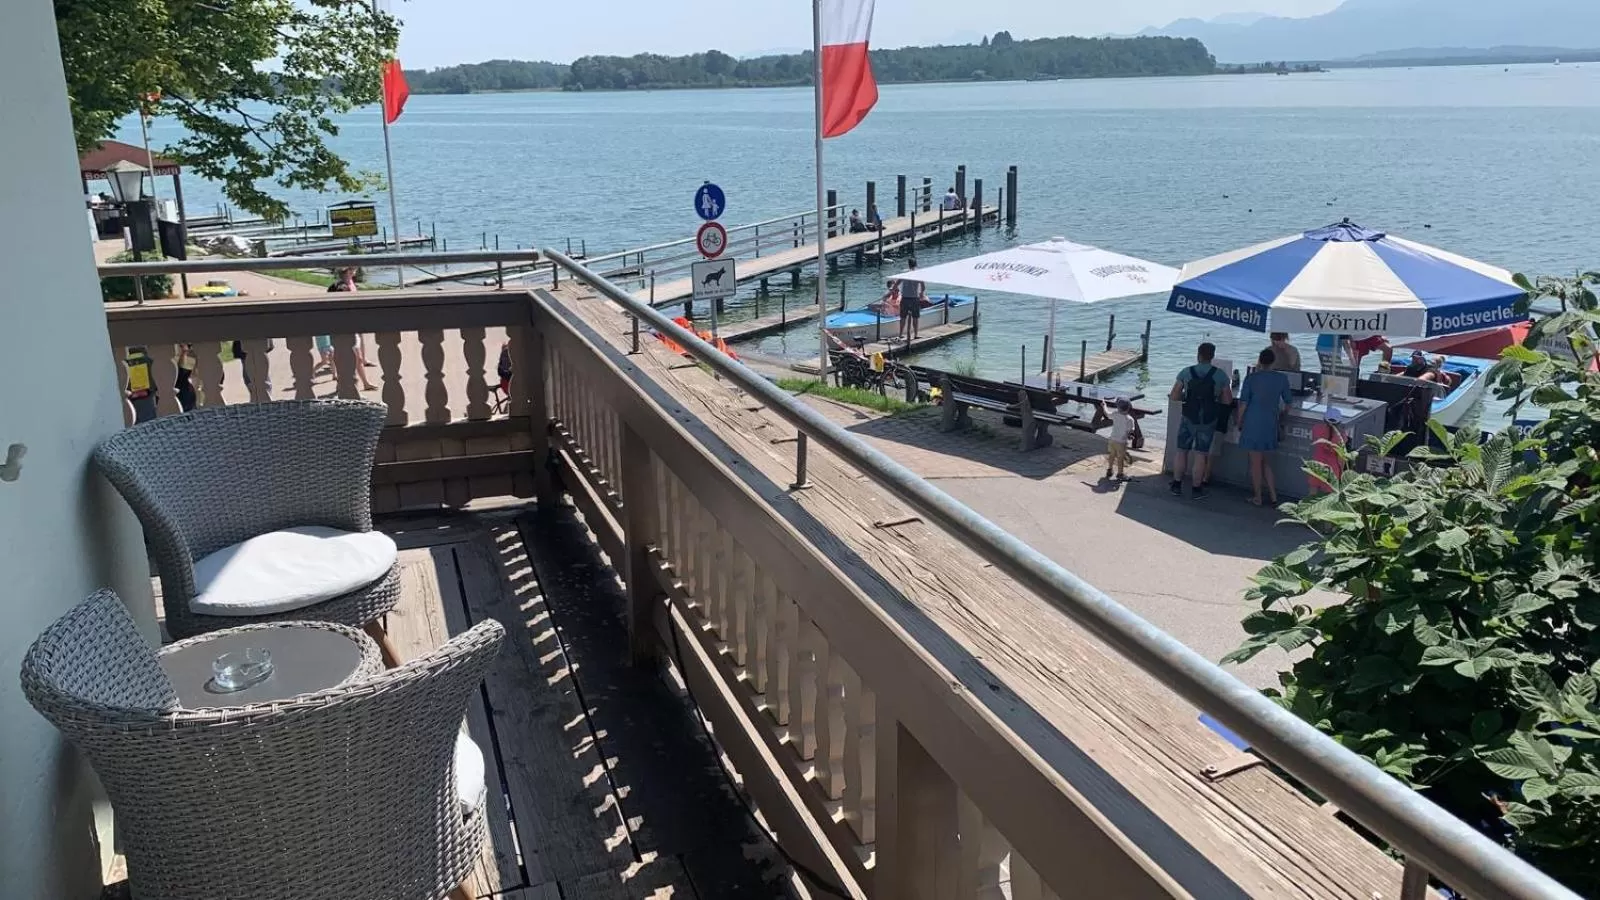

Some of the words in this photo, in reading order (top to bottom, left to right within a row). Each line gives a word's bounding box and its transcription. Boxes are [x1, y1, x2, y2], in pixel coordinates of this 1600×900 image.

[1175, 295, 1261, 326] Bootsverleih
[1306, 312, 1388, 331] Wörndl
[1431, 304, 1525, 330] Bootsverlei
